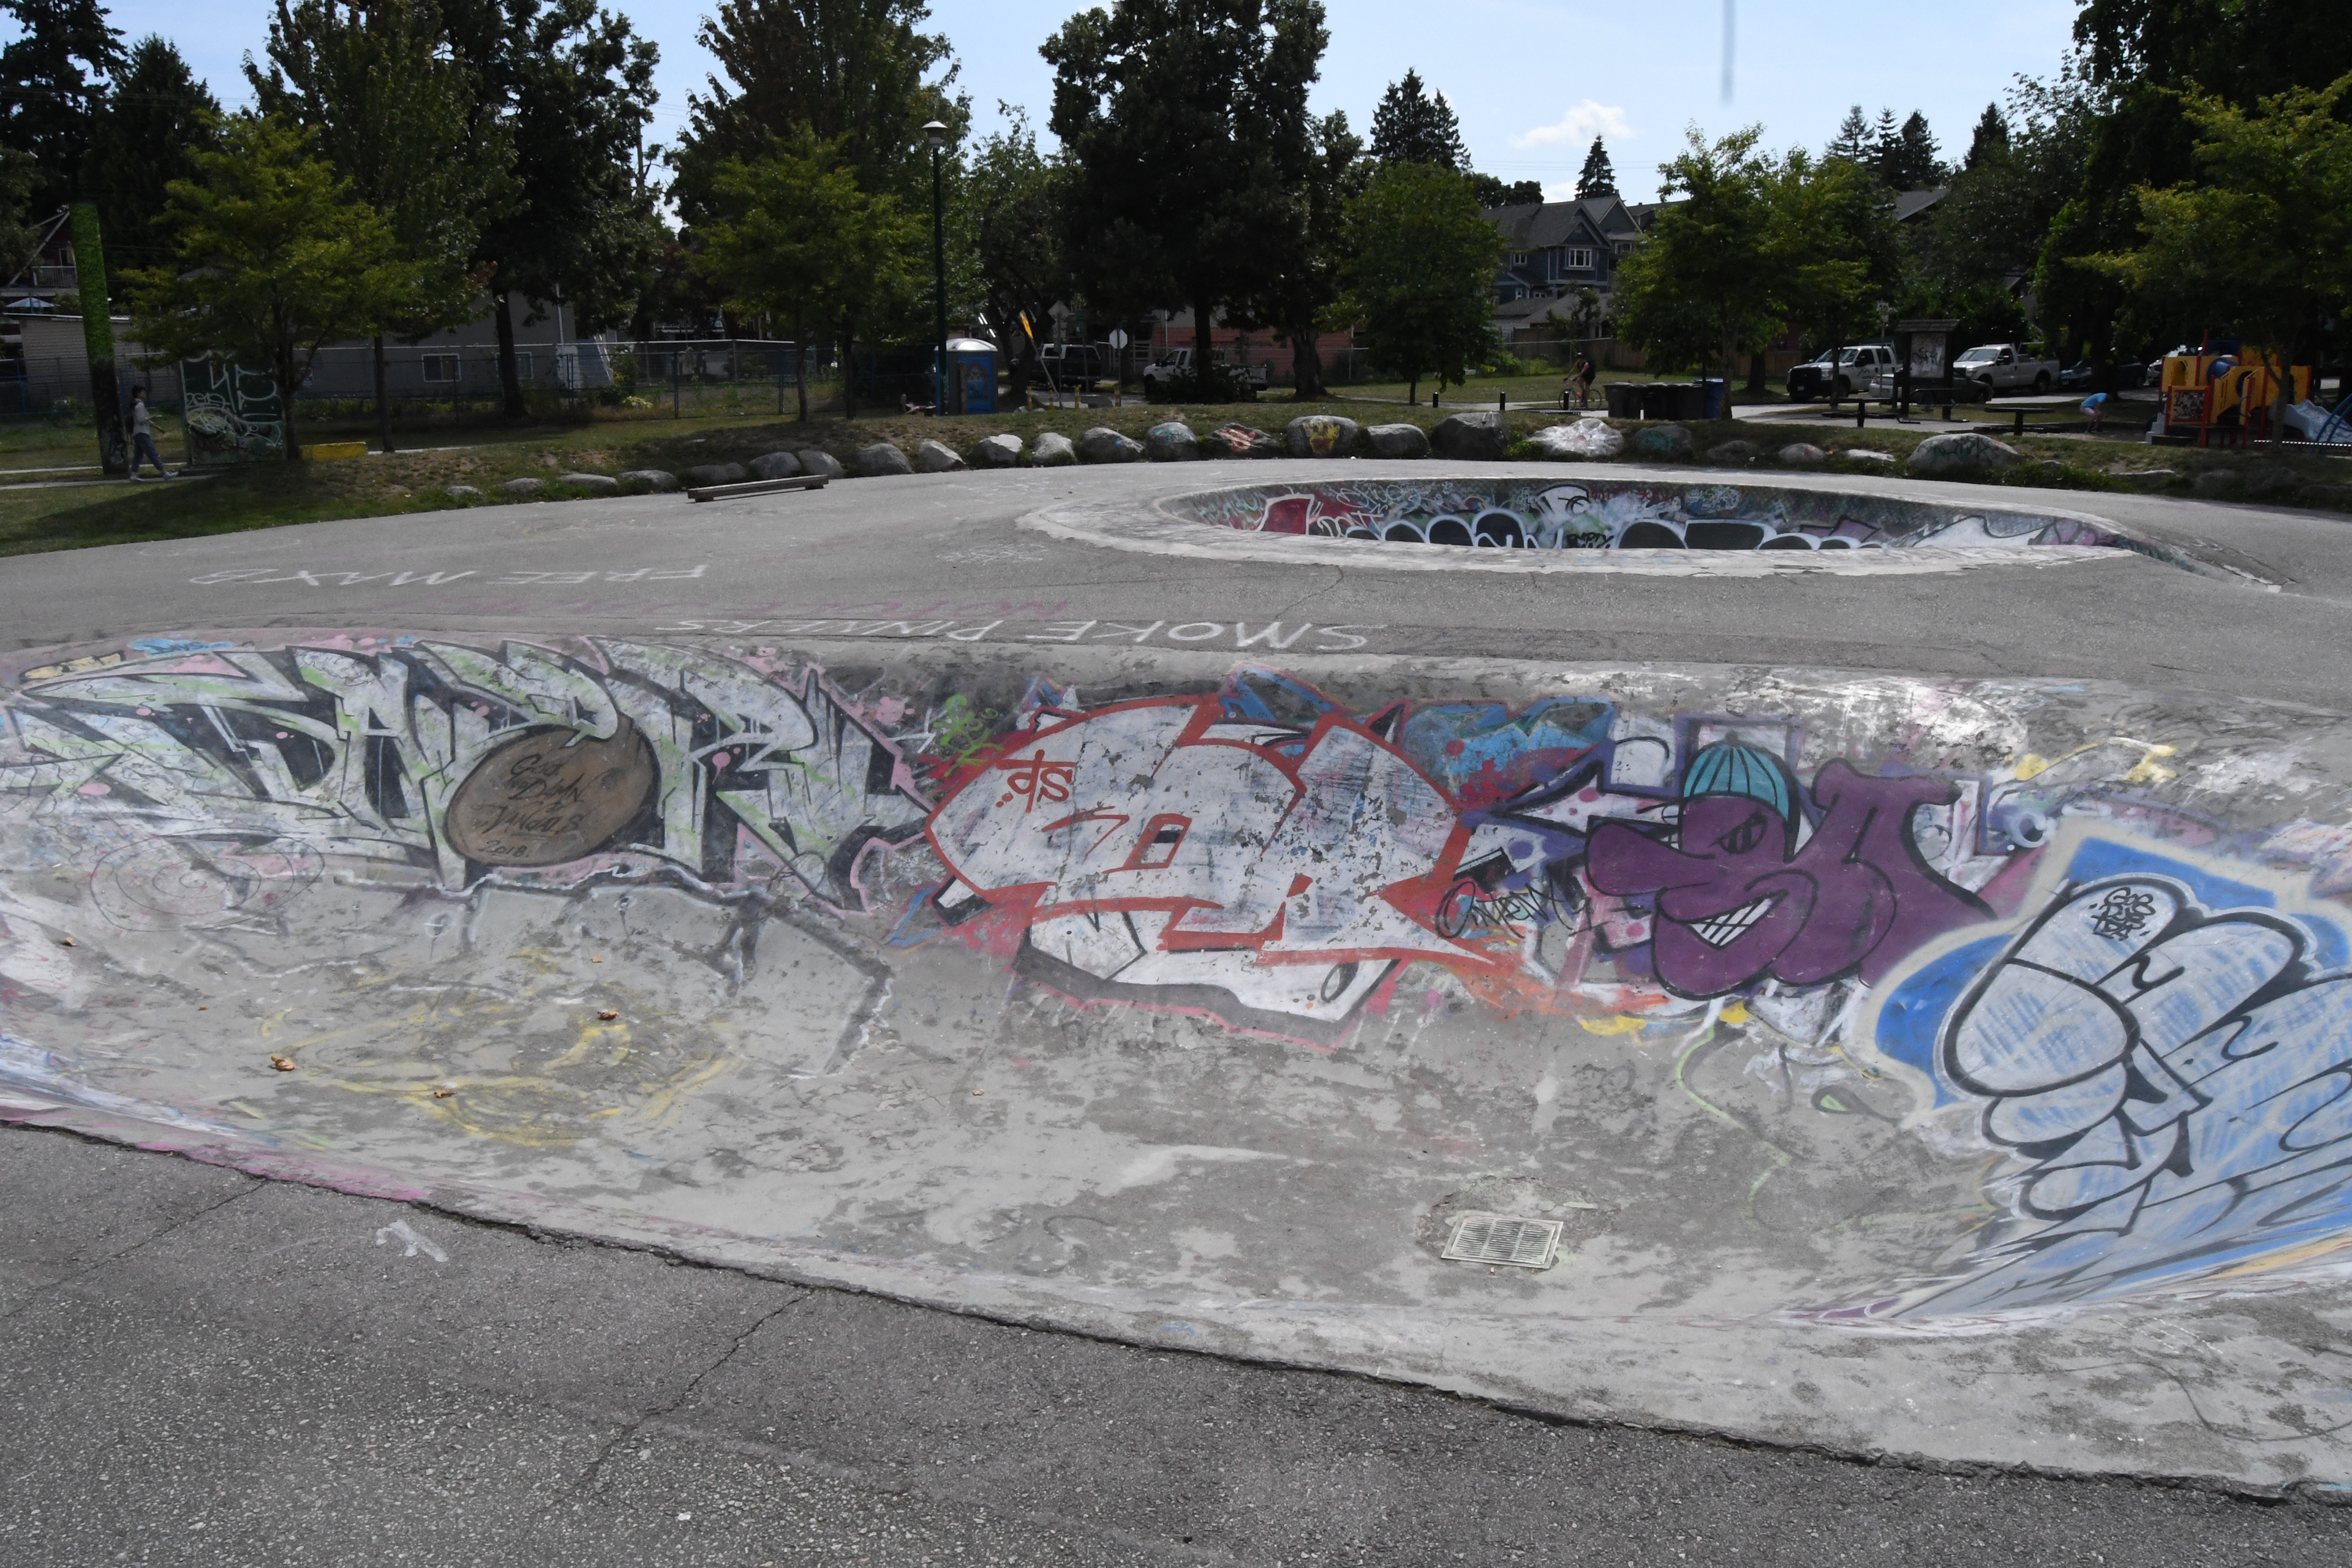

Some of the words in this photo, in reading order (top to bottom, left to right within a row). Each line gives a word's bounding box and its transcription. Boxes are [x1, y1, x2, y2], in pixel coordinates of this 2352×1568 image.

[486, 564, 709, 584] FREE
[655, 619, 1005, 641] PINNERS
[1025, 619, 1387, 650] SMOKE
